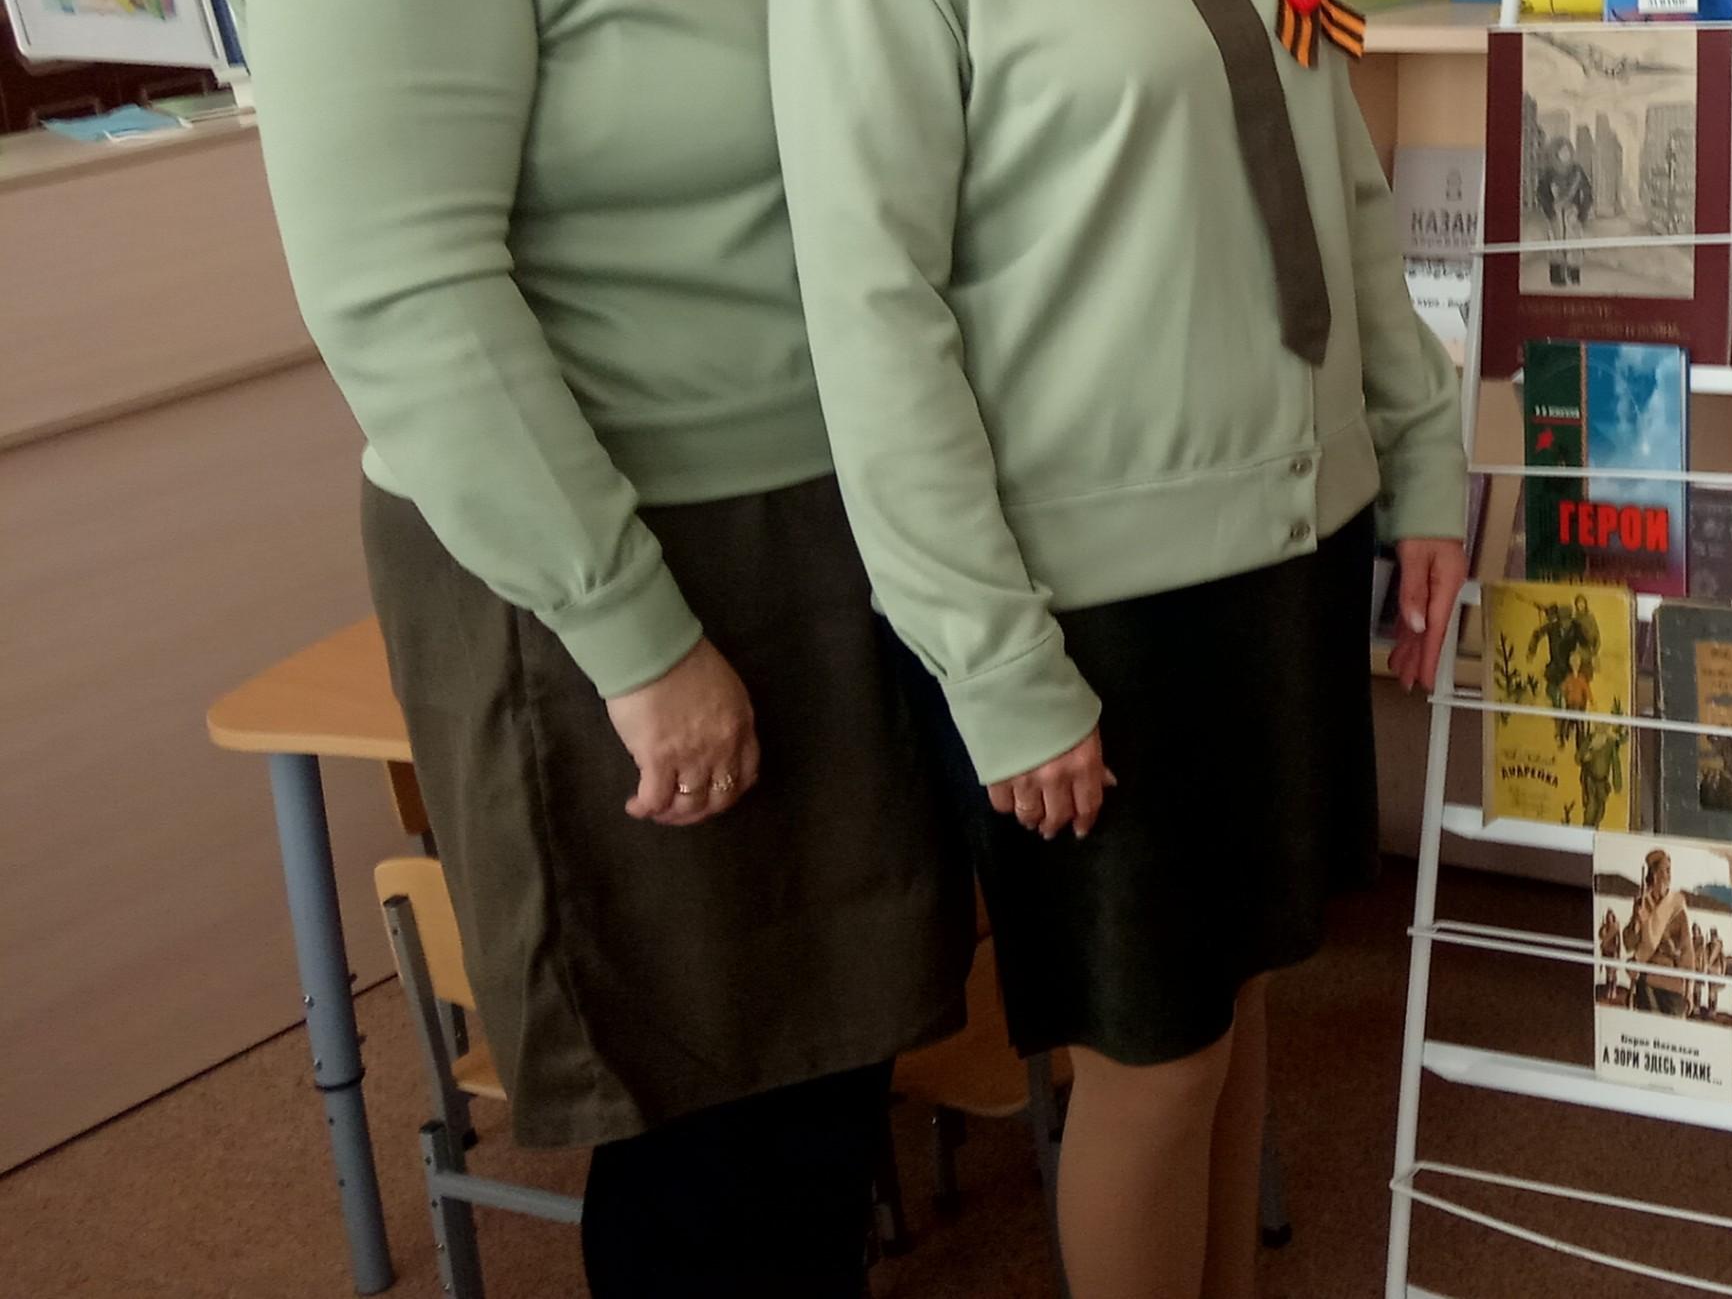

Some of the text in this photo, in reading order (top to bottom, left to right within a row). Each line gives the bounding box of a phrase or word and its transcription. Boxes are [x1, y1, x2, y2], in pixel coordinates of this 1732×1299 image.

[1558, 500, 1670, 553] ГЕРОИ
[1602, 1045, 1610, 1064] А
[1614, 1047, 1639, 1069] ЗОРИ
[1644, 1052, 1676, 1076] ЗДЕСЬ
